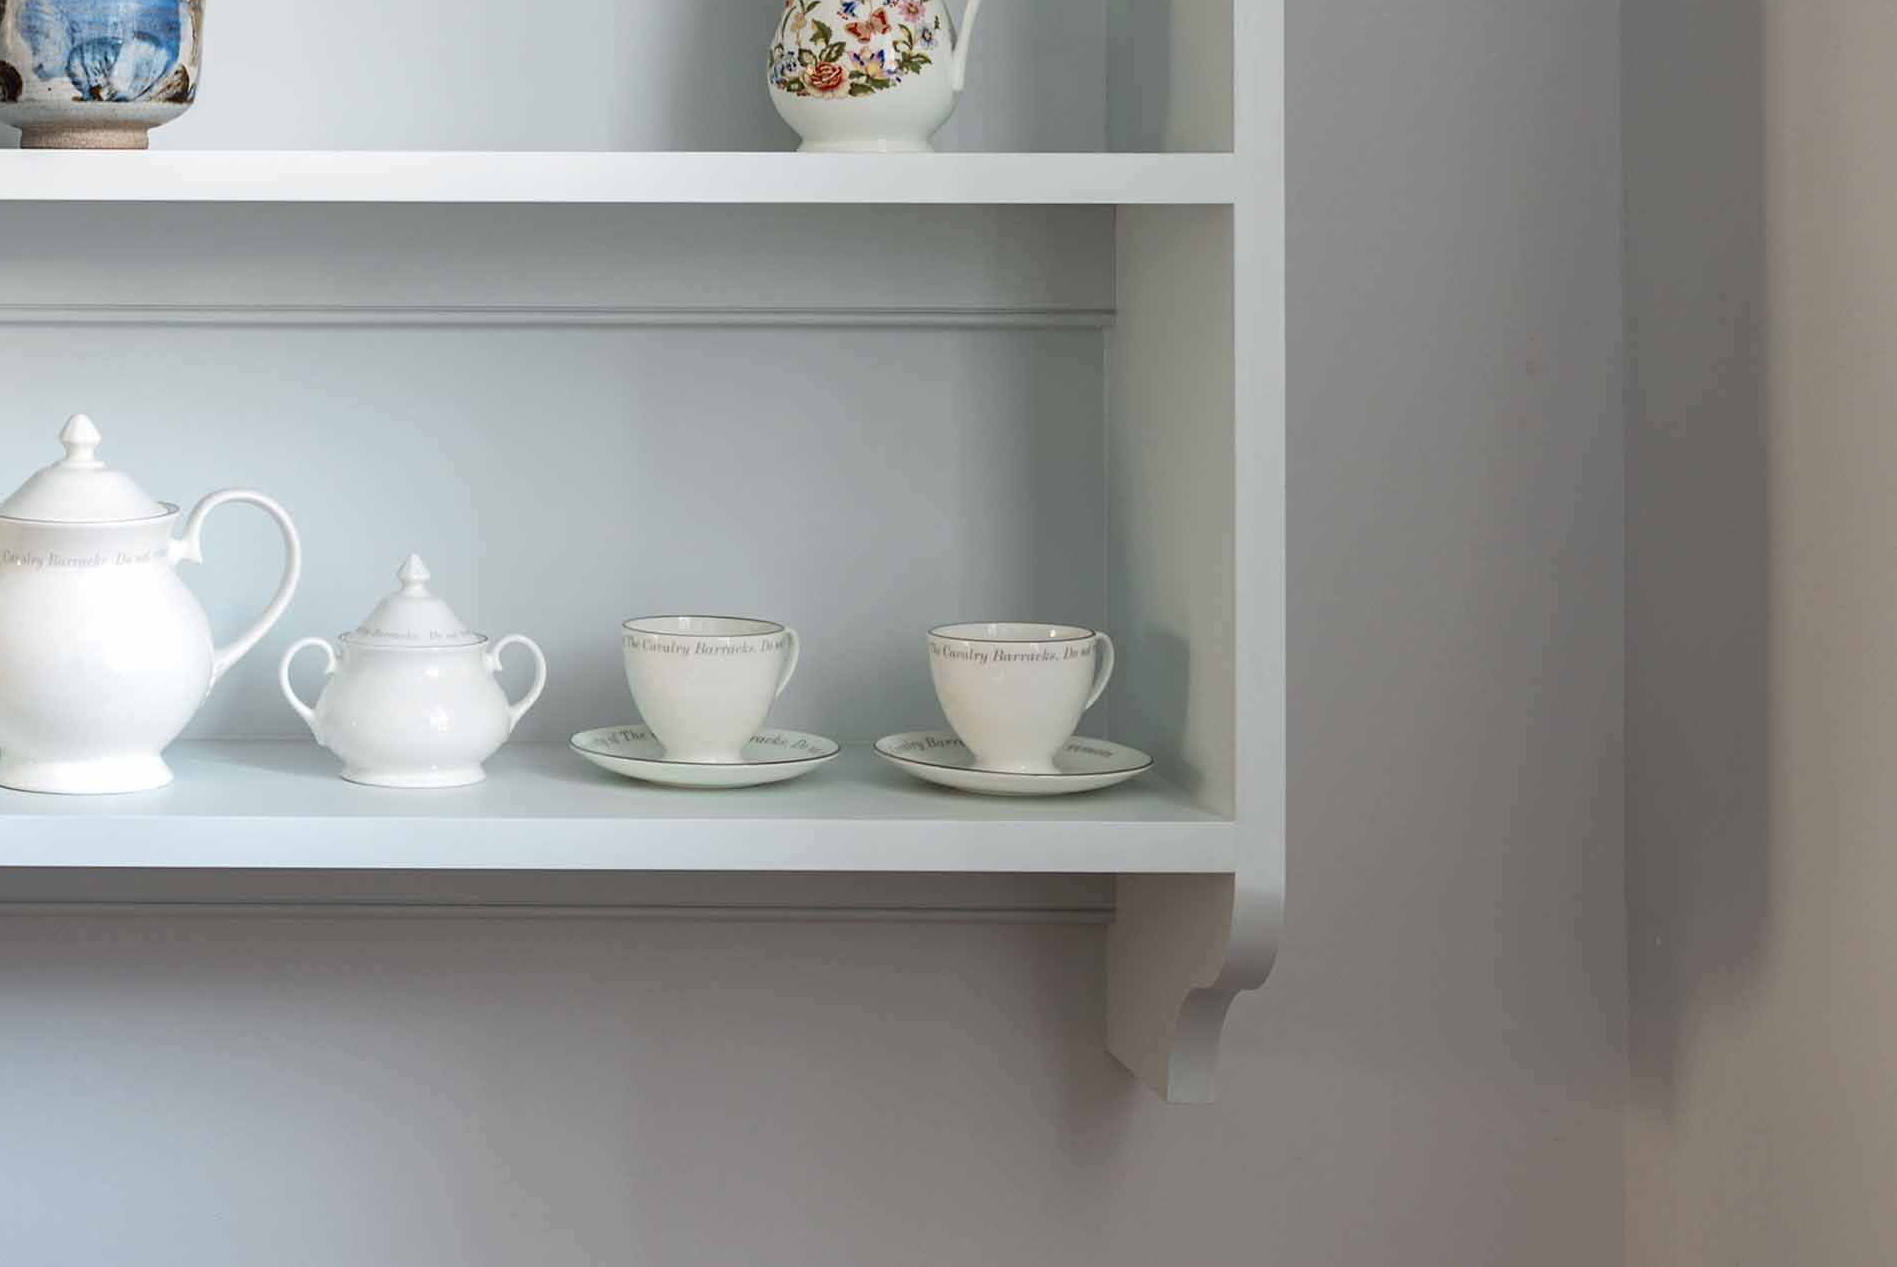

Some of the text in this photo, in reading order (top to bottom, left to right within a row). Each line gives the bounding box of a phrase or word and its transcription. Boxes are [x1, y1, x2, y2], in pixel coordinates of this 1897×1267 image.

[642, 636, 691, 657] Cavalry
[941, 644, 989, 664] Cavalry
[1062, 645, 1078, 660] Do
